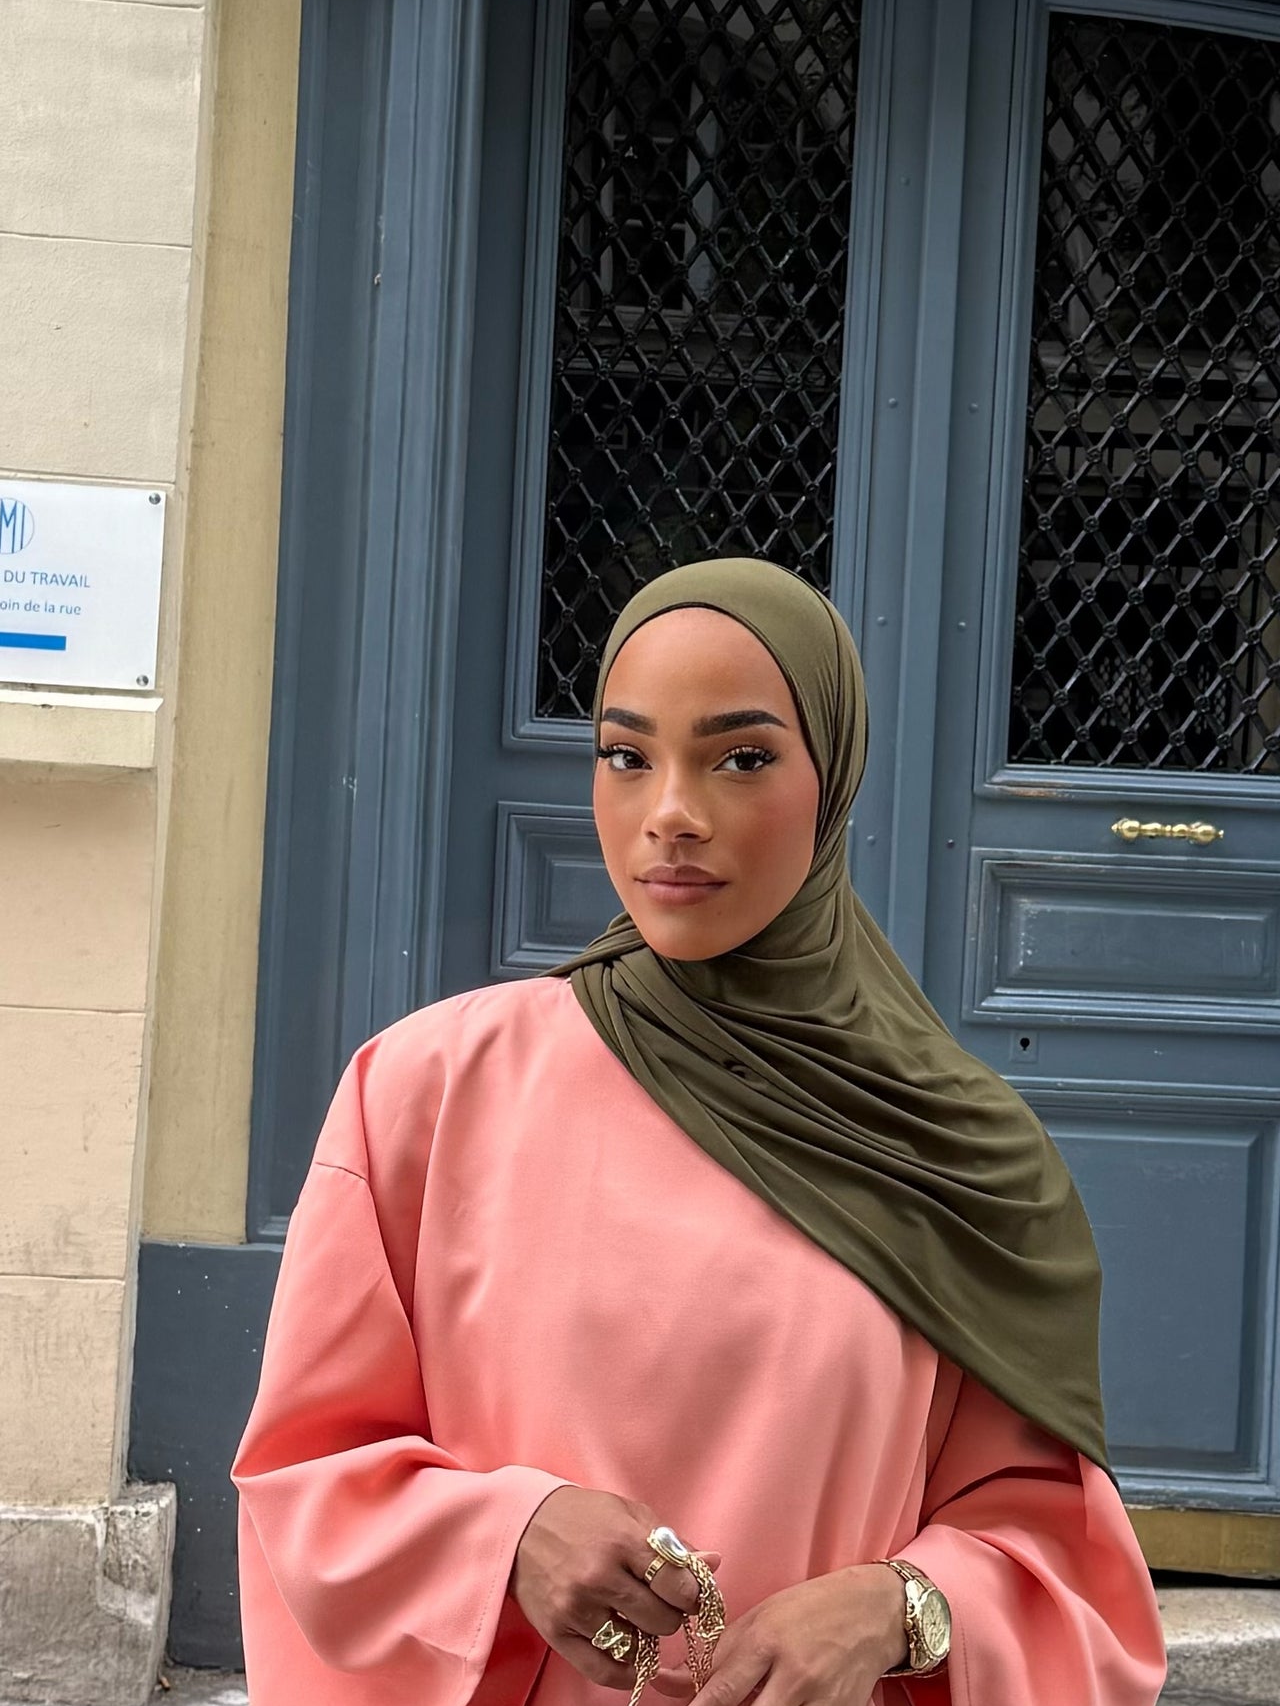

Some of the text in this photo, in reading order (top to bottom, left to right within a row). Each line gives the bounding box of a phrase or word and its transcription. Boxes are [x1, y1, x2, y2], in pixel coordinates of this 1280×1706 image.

[4, 569, 26, 584] DU
[31, 571, 91, 589] TRAVAIL
[23, 599, 41, 613] de
[44, 601, 56, 614] la
[59, 604, 82, 616] rue
